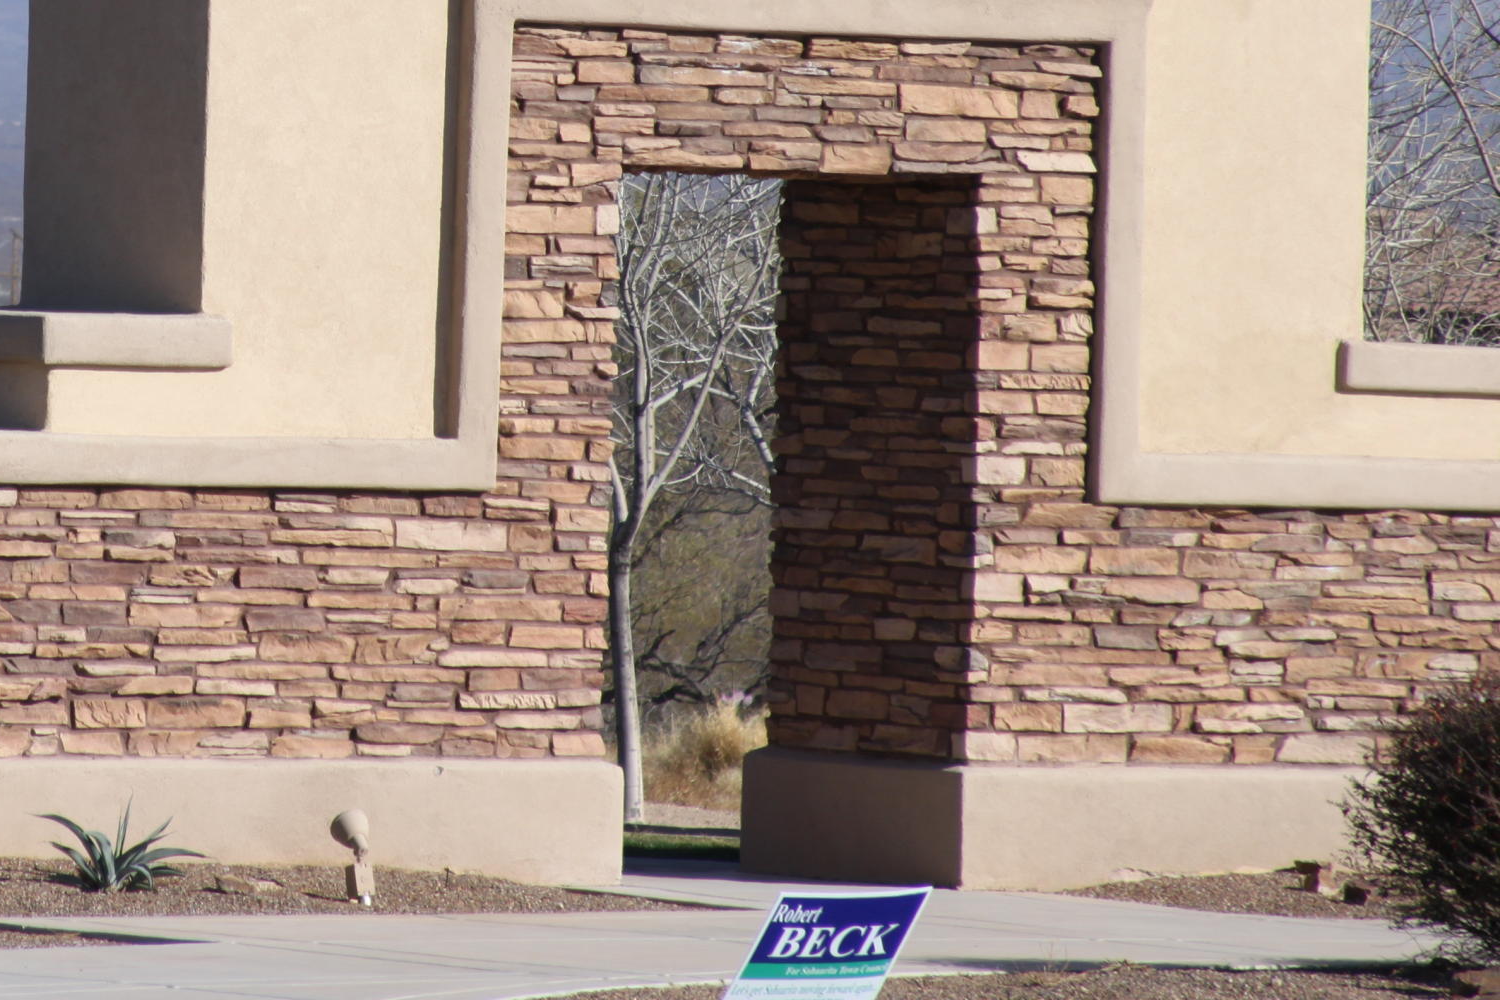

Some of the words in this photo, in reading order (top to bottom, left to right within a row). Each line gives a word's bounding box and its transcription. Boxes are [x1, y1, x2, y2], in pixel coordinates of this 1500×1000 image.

[772, 904, 823, 923] Robert
[767, 923, 900, 958] BECK
[785, 966, 799, 976] For
[839, 964, 858, 975] Town
